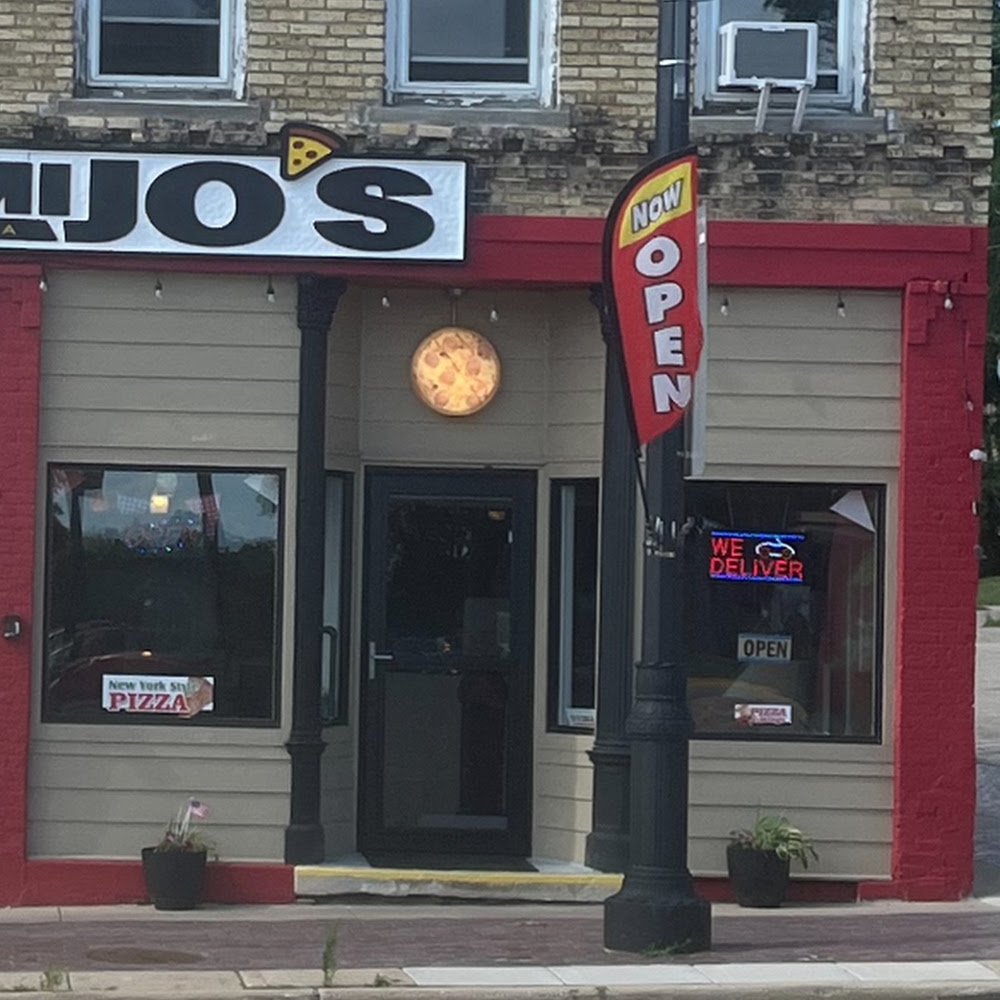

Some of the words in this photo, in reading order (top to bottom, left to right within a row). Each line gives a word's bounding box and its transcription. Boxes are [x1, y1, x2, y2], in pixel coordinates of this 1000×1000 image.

[631, 178, 684, 234] NOW
[634, 235, 693, 414] OPEN
[711, 537, 745, 557] WE
[709, 558, 804, 579] DELIVER
[743, 639, 789, 659] OPEN
[108, 681, 137, 691] New
[139, 681, 167, 692] York
[109, 692, 190, 712] PIZZA
